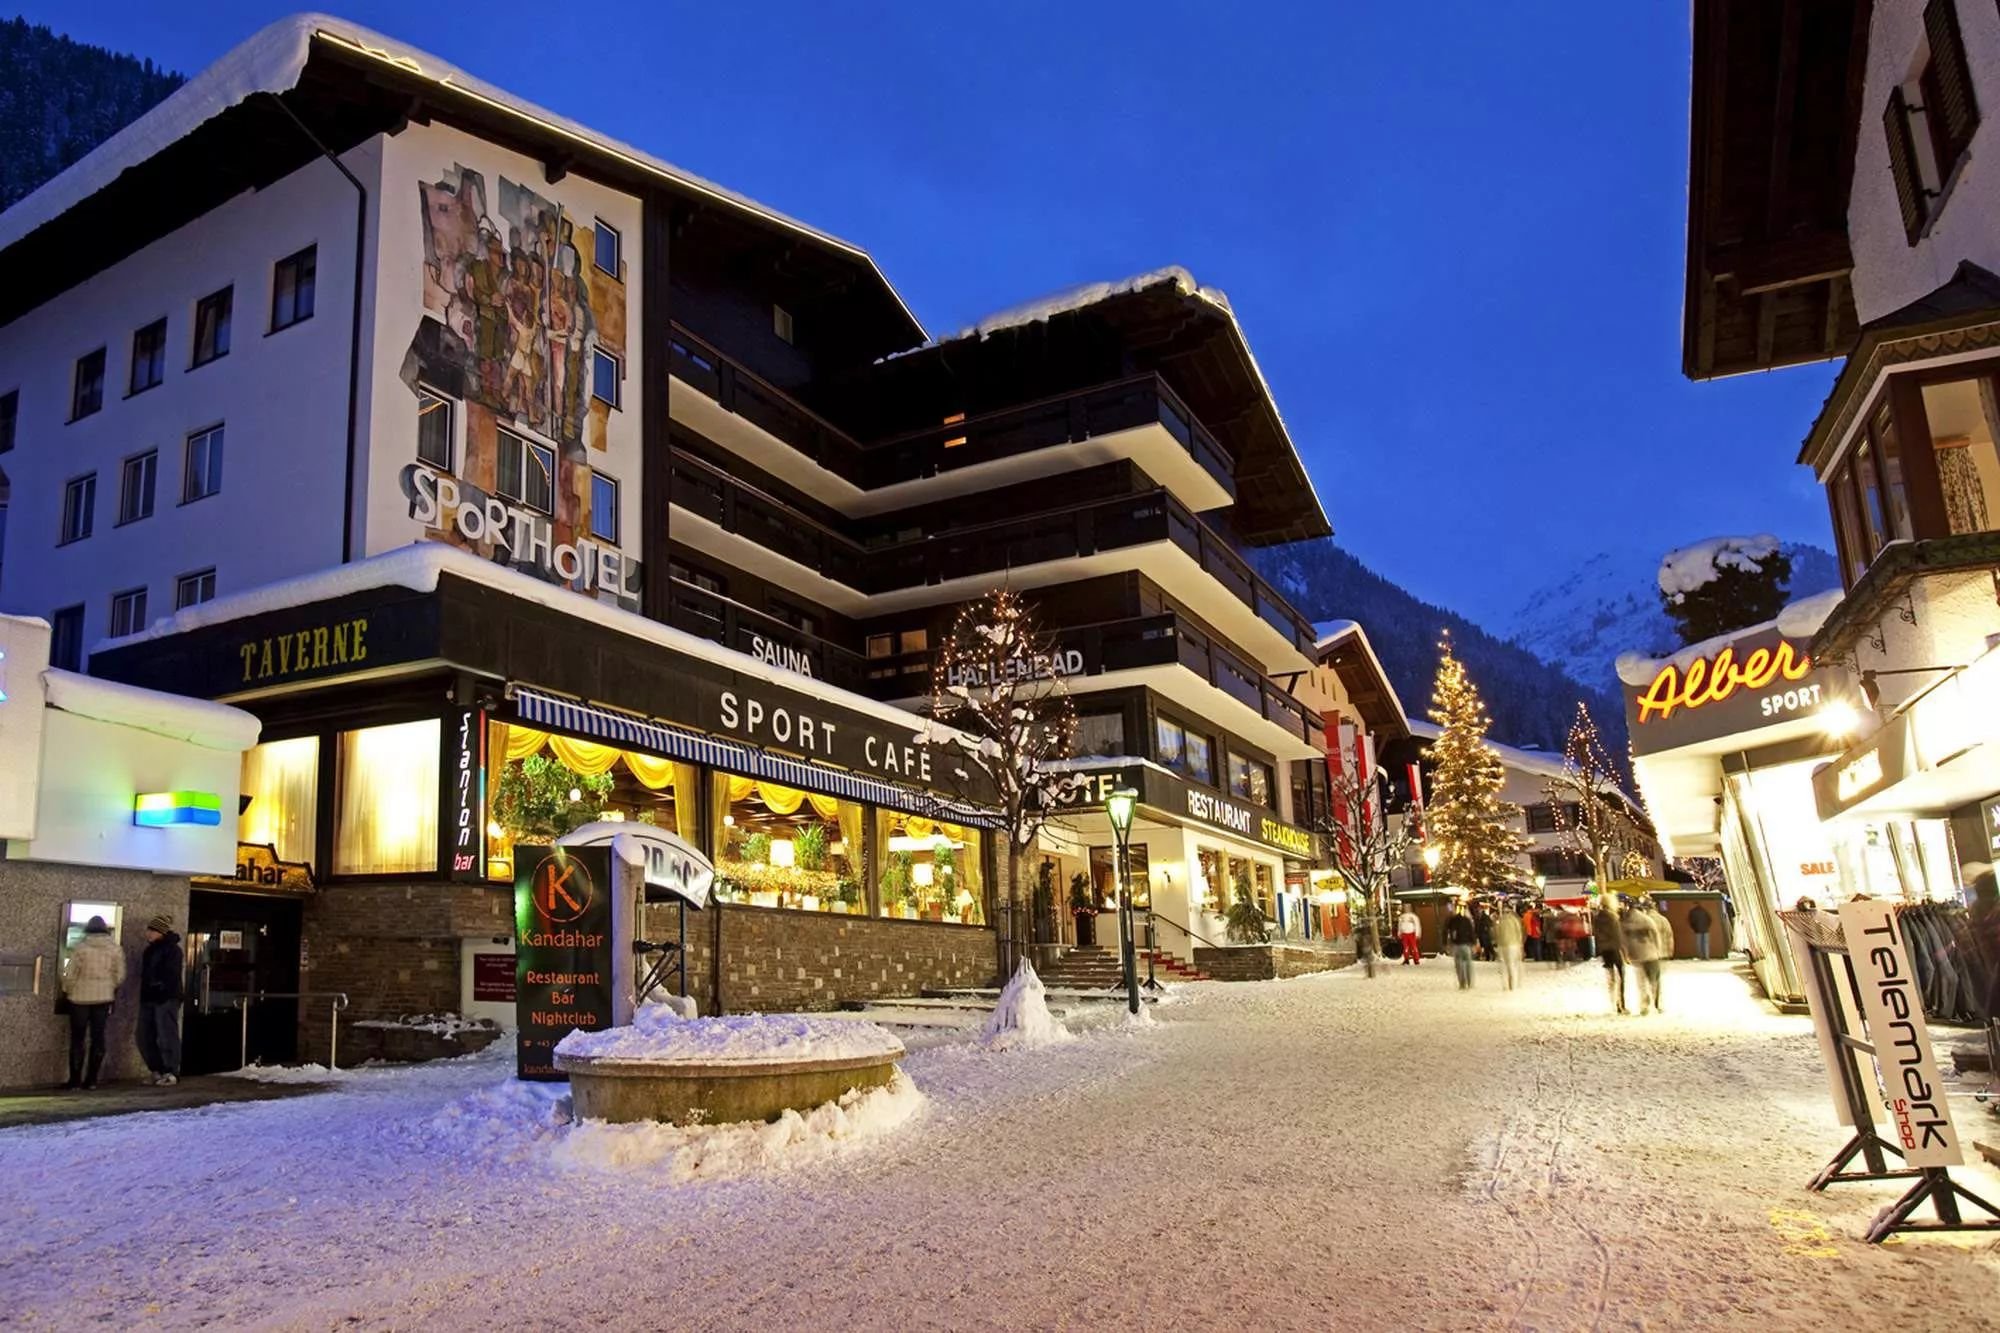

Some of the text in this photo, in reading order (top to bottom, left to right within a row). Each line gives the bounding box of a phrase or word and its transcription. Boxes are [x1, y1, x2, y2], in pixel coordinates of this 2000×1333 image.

[413, 467, 638, 601] SPORTHOTEL
[240, 618, 368, 682] TAVERNE
[752, 636, 813, 678] SAUNA
[1637, 640, 1812, 724] Alber
[1760, 684, 1821, 717] SPORT
[720, 691, 836, 755] SPORT
[1038, 772, 1122, 806] OTE
[1187, 790, 1310, 853] RESTAURANT STEAKHOUSE
[236, 857, 288, 885] ahar
[453, 853, 476, 871] bar
[1800, 861, 1836, 876] SALE
[547, 864, 581, 912] K
[521, 928, 603, 948] Kandahar
[527, 970, 600, 985] Restaurant
[552, 991, 576, 1005] Bar
[532, 1011, 597, 1026] Nightclub
[1864, 913, 1948, 1149] Telemark
